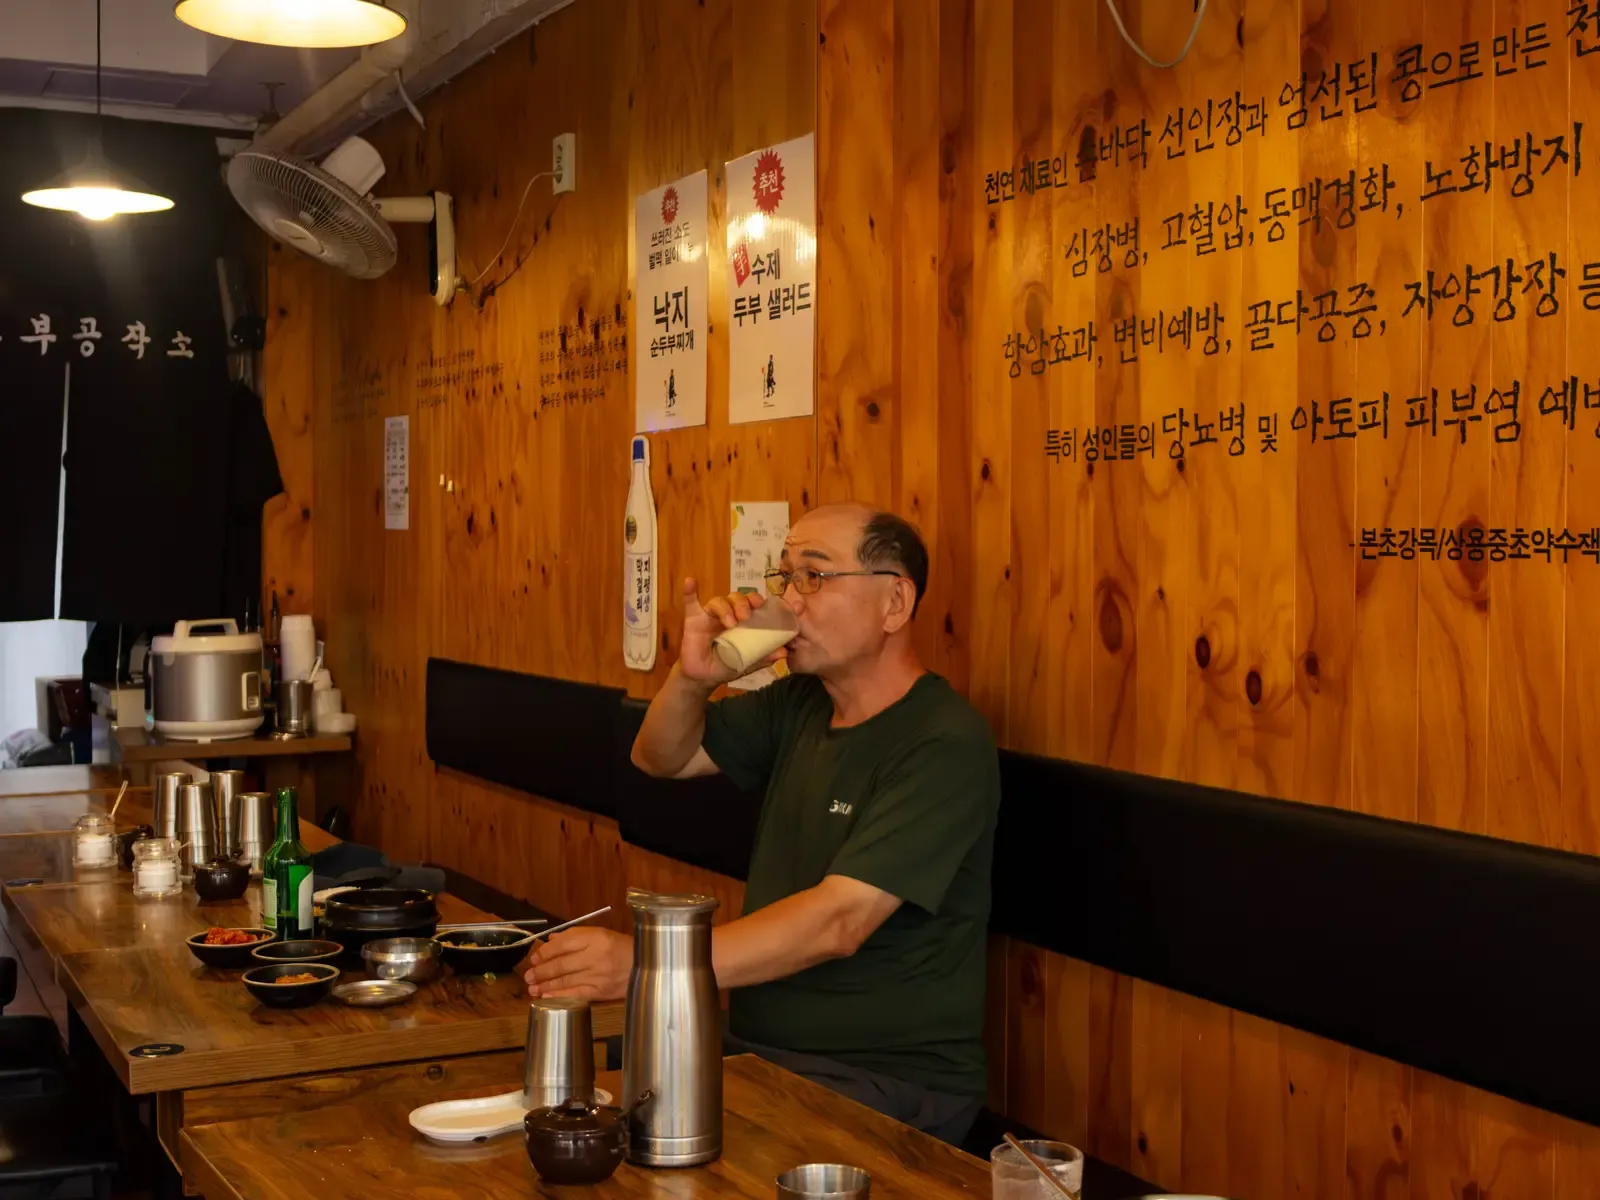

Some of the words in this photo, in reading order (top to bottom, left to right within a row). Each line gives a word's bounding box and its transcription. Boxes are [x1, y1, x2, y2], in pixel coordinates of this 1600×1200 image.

[985, 166, 1015, 205] 천연
[1020, 152, 1068, 195] 재료인
[1075, 119, 1151, 184] 손바닥
[1159, 92, 1268, 160] 선인장과
[1279, 53, 1377, 130] 엄선된
[1392, 44, 1483, 102] 콩으로
[1493, 23, 1550, 77] 만든
[759, 169, 778, 196] 추천
[1066, 217, 1148, 277] 심장병,
[1161, 195, 1254, 256] 고혈압,
[1259, 163, 1403, 242] 동맥경화,
[1420, 121, 1583, 198] 노화방지
[651, 227, 673, 247] 쓰러진
[674, 222, 692, 240] 소도
[648, 252, 663, 270] 벌떡
[751, 249, 780, 285] 수제
[654, 286, 688, 332] 낙지
[733, 293, 762, 327] 두부
[767, 283, 811, 320] 샐러드
[1002, 321, 1103, 378] 항암효과,
[1114, 302, 1231, 364] 변비예방,
[1244, 282, 1386, 350] 골다공증,
[1402, 251, 1566, 326] 자양강장
[0, 313, 194, 360] 부공작소
[650, 329, 694, 358] 순두부찌개
[1044, 427, 1076, 463] 특히
[1082, 421, 1155, 463] 성인들의
[1162, 402, 1245, 459] 당뇨병
[1258, 412, 1278, 453] 및
[1291, 391, 1390, 443] 아토피
[1404, 380, 1520, 444] 피부염
